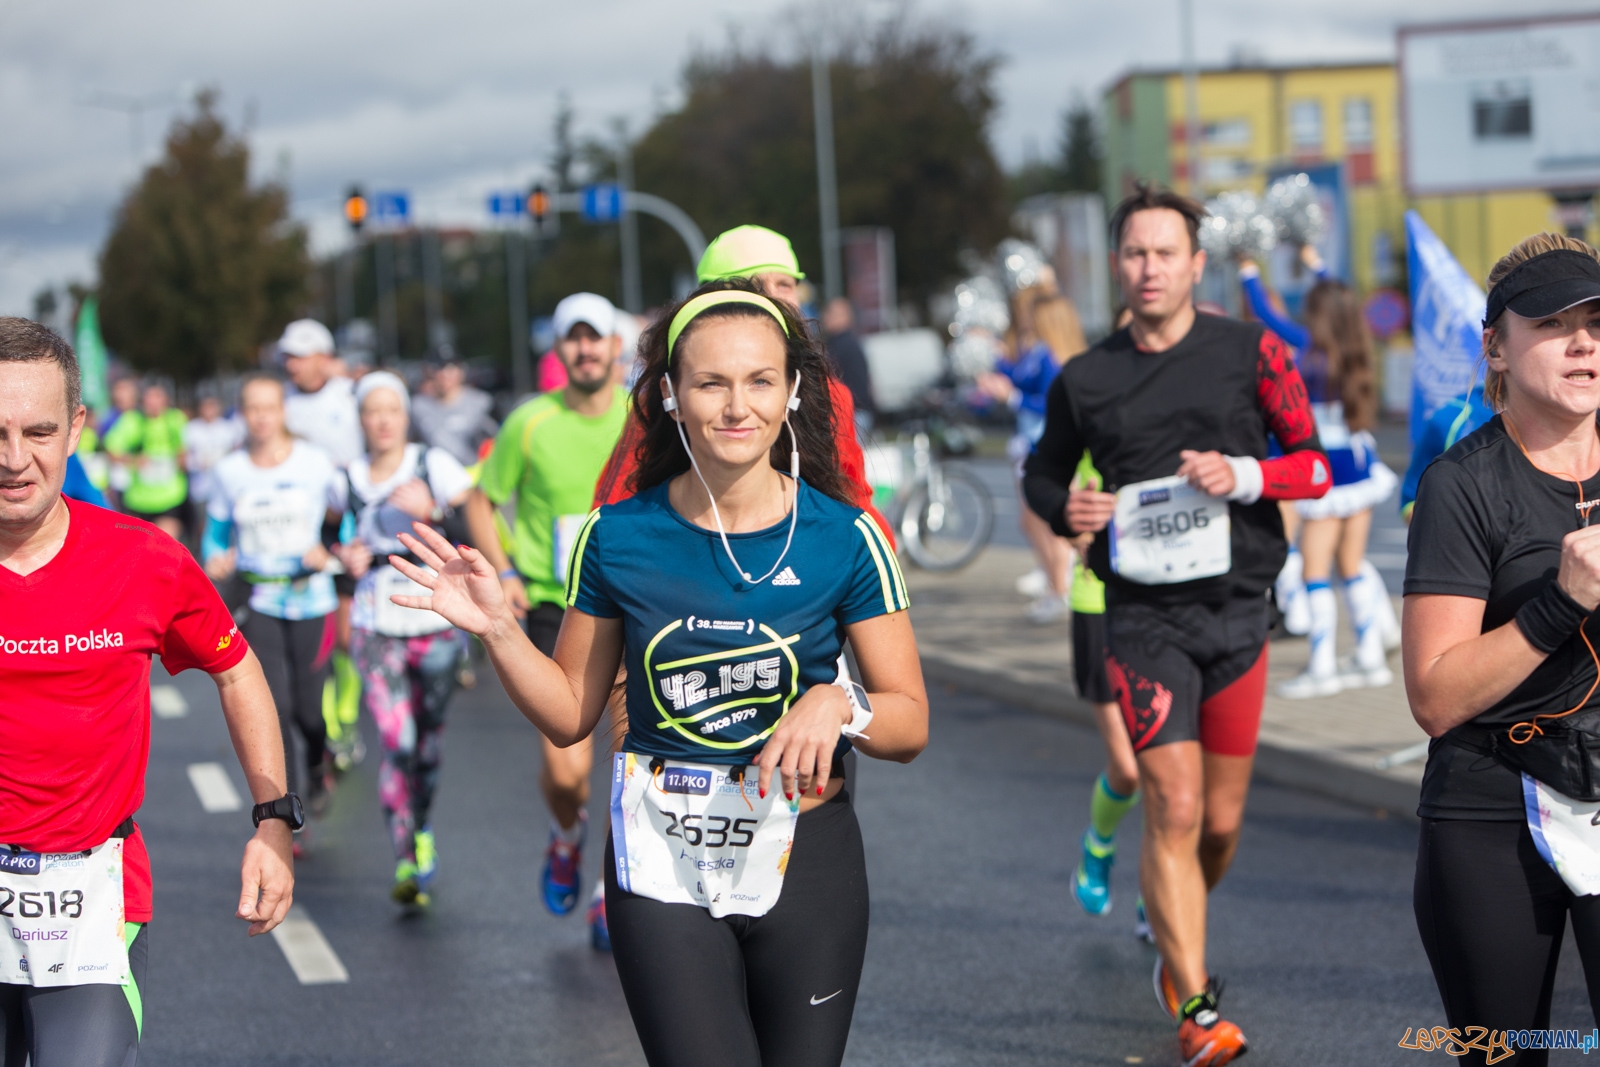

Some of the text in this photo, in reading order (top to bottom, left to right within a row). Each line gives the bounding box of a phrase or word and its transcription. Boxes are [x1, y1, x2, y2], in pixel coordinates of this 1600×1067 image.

[1138, 506, 1210, 539] 3606
[772, 578, 801, 586] adidas
[696, 619, 712, 629] 38.
[65, 628, 124, 653] Polska
[700, 708, 757, 734] since 1979
[659, 810, 758, 847] 2635
[0, 887, 84, 918] 2618
[12, 927, 68, 941] Dariusz
[48, 963, 64, 973] 4F
